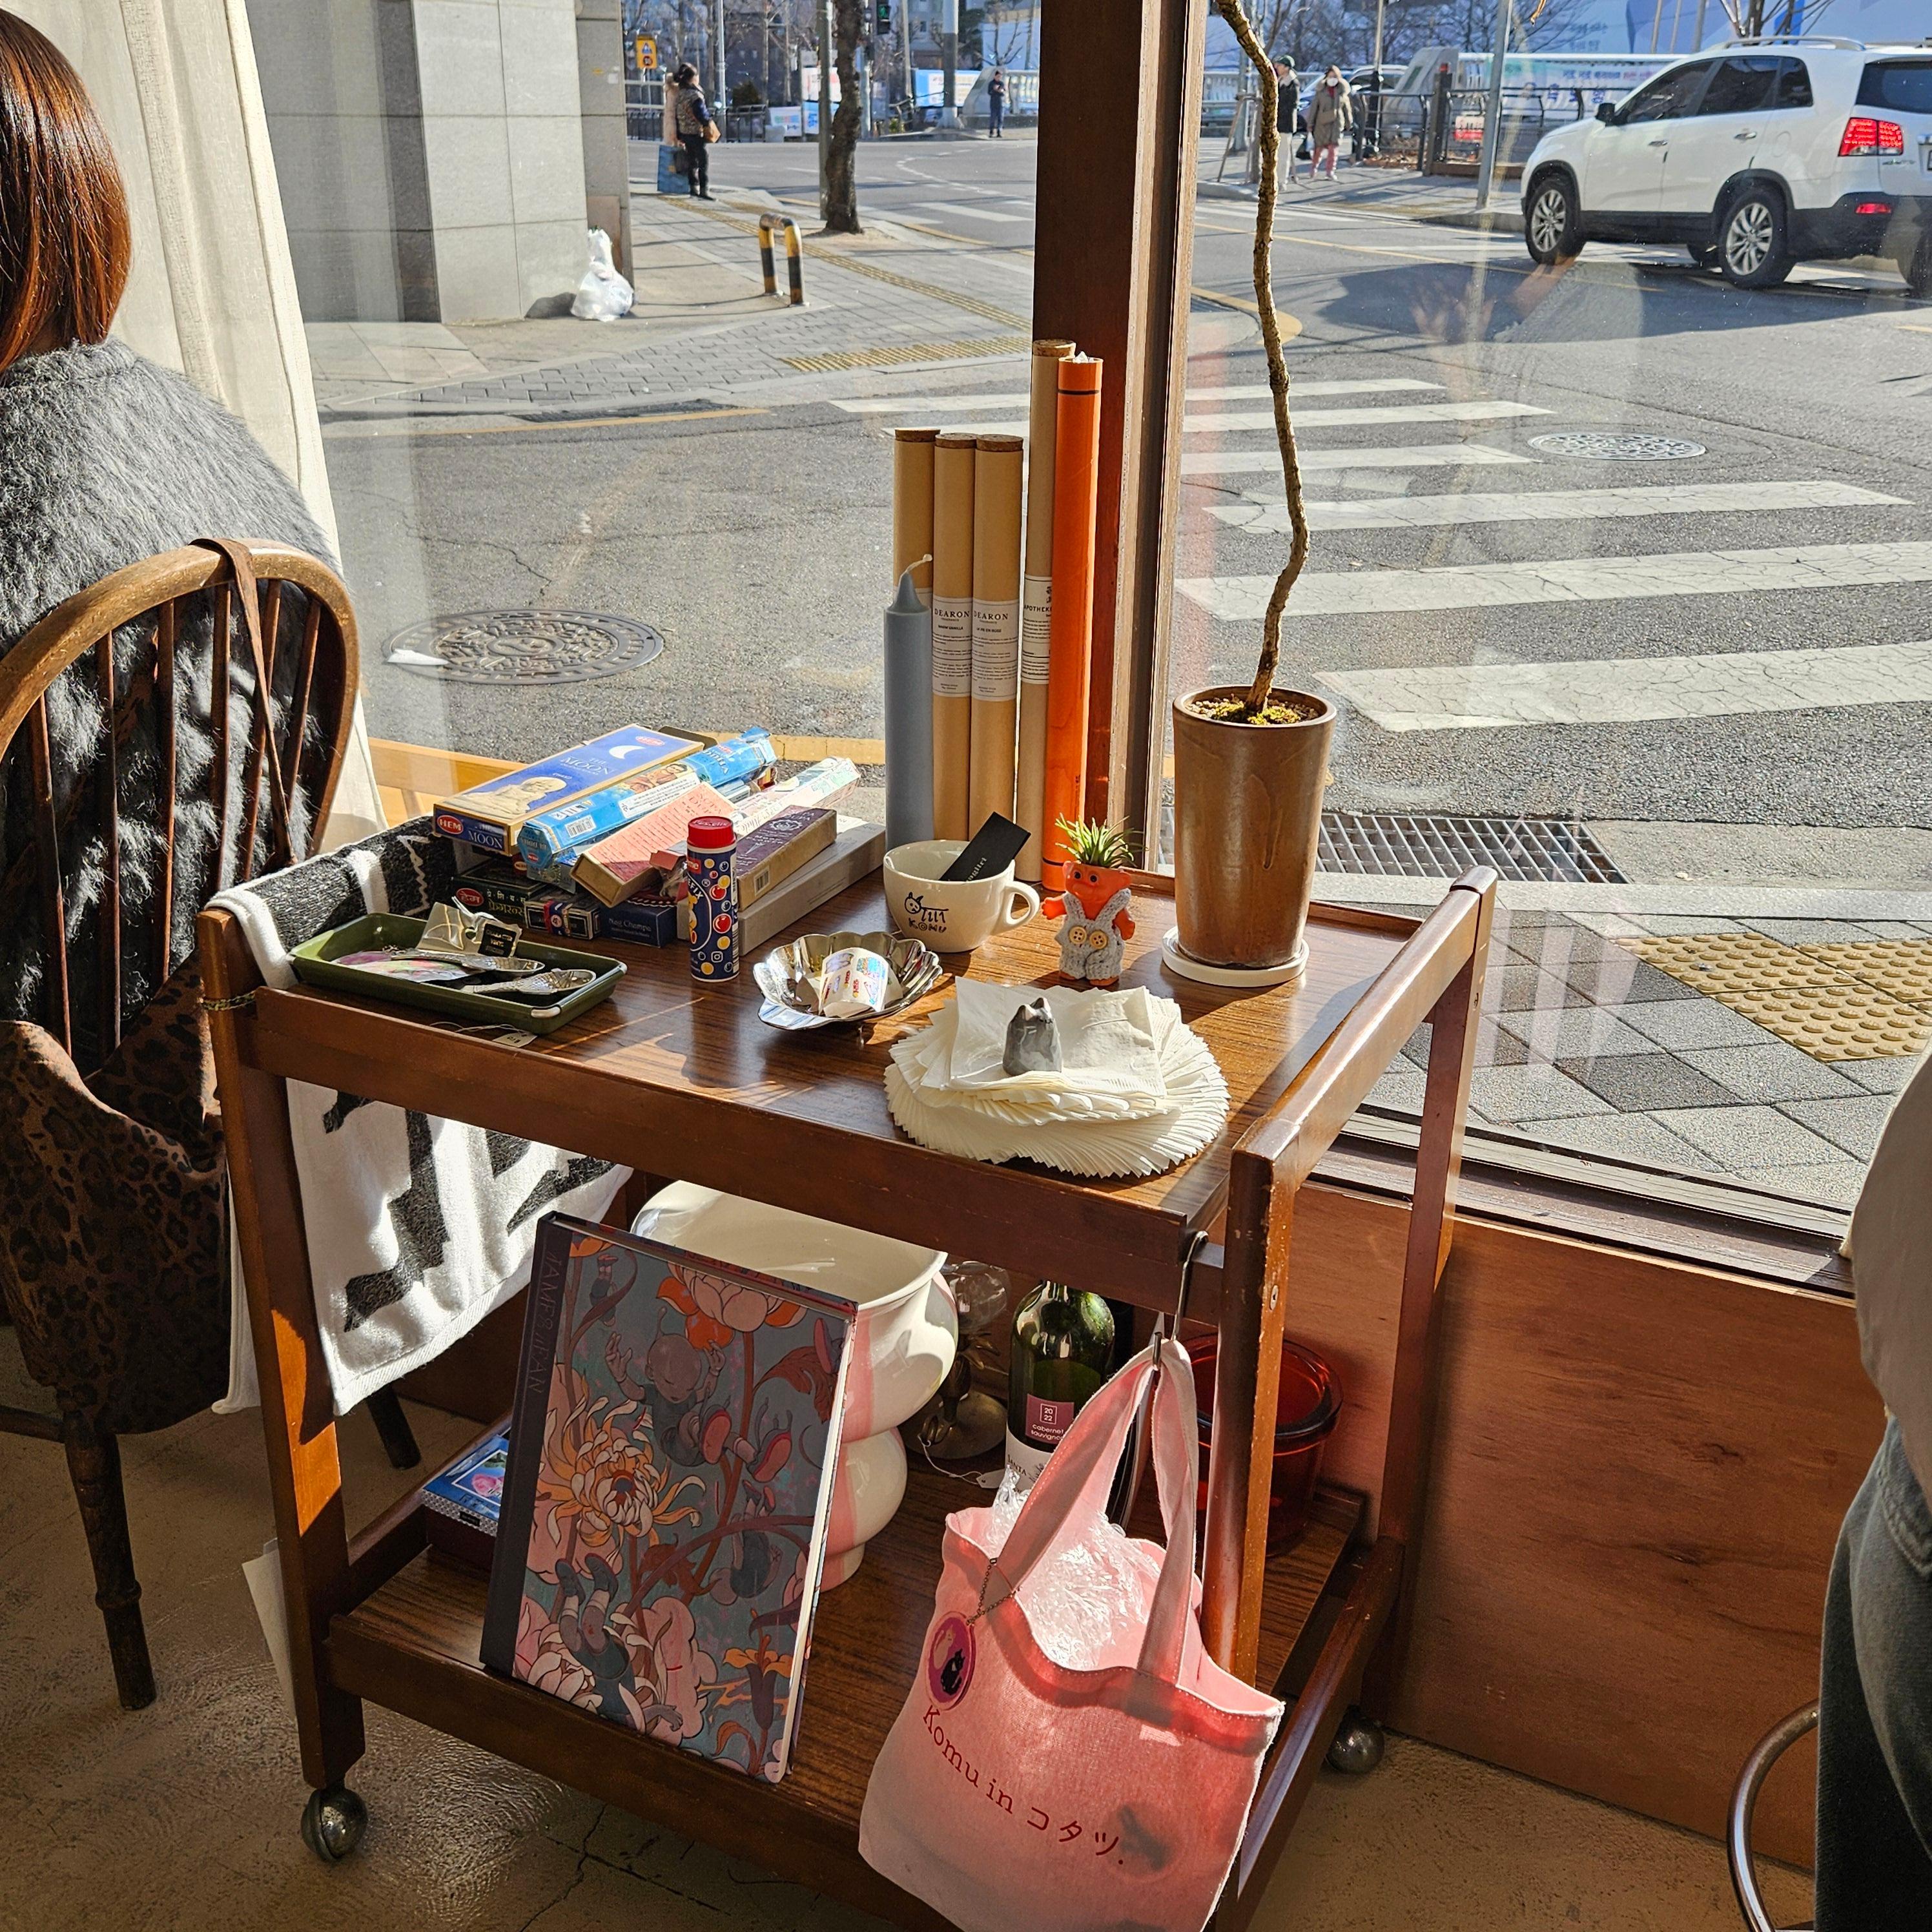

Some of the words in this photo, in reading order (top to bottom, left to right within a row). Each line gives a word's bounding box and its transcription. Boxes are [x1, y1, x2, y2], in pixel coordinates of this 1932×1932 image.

[934, 609, 970, 618] DEARON
[974, 611, 1008, 620] DEARON
[560, 755, 614, 775] MOON
[439, 819, 462, 832] HEM
[468, 830, 504, 848] MOON
[909, 917, 947, 932] KOMU
[1030, 1429, 1064, 1441] sauvigno
[1032, 1423, 1065, 1435] cabernet
[923, 1705, 981, 1788] Komu
[986, 1778, 1014, 1814] in
